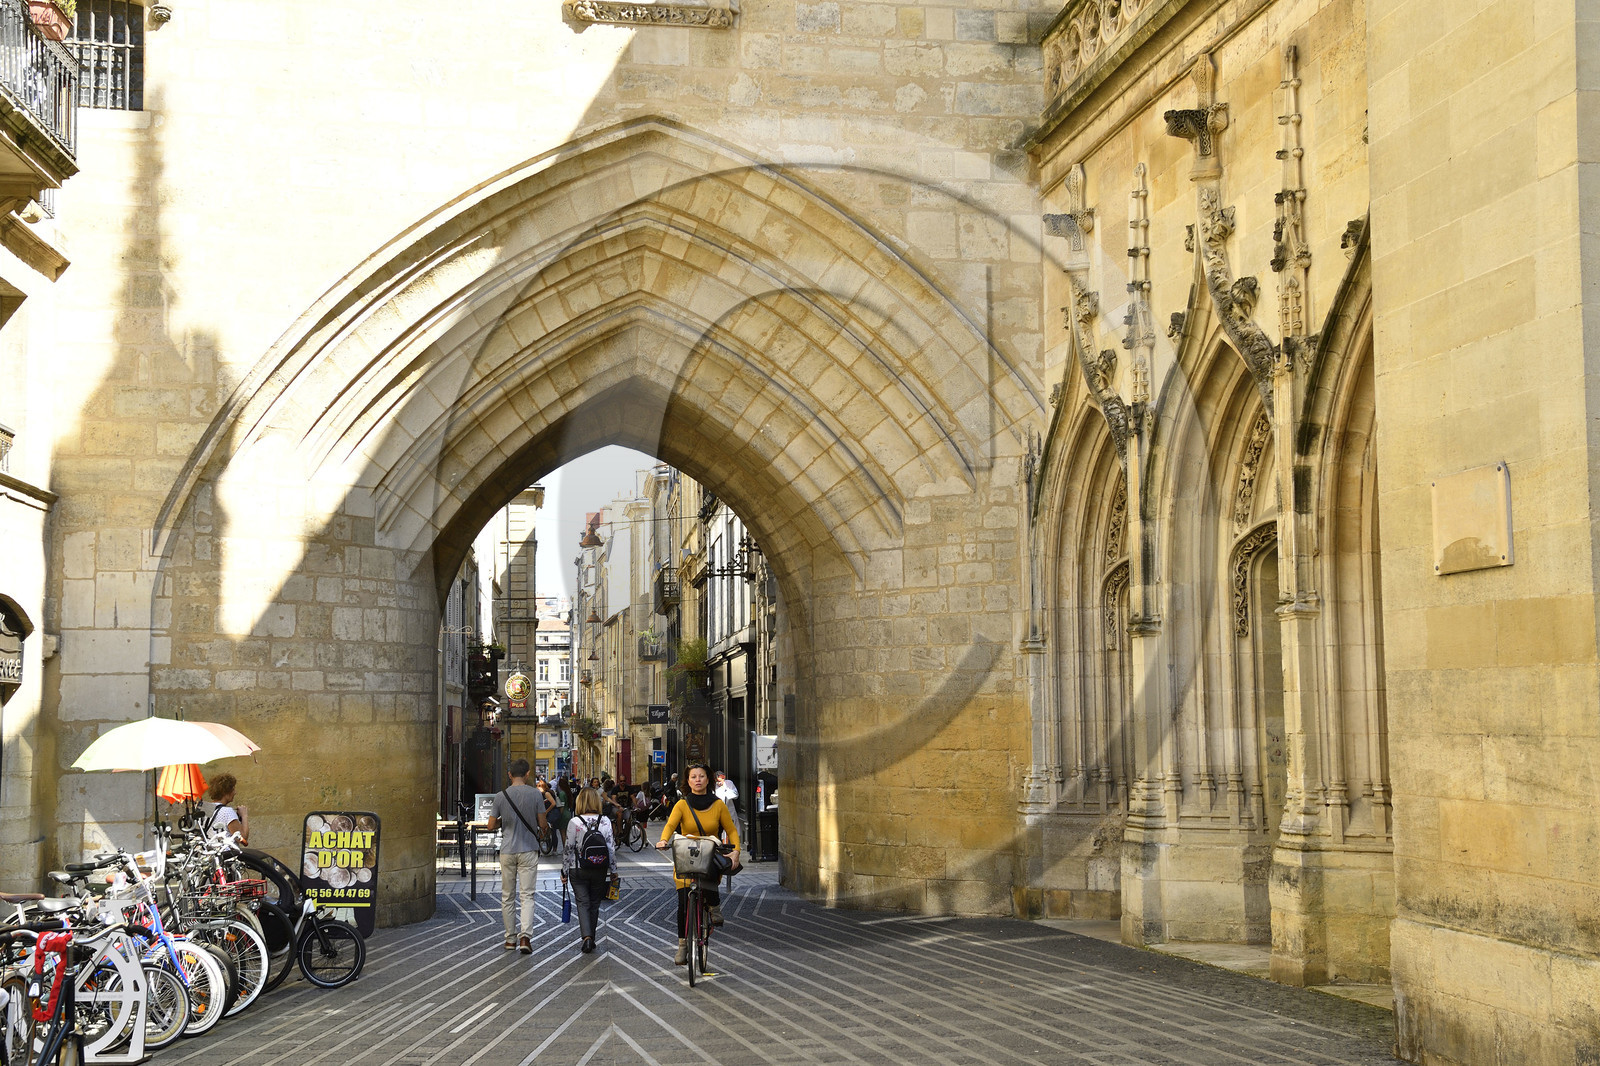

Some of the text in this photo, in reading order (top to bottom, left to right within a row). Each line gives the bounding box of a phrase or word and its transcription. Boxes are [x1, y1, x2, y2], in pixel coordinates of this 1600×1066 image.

[309, 832, 375, 849] ACHAT
[318, 851, 364, 868] D'OR
[306, 889, 370, 898] 05 56 44 47 69
